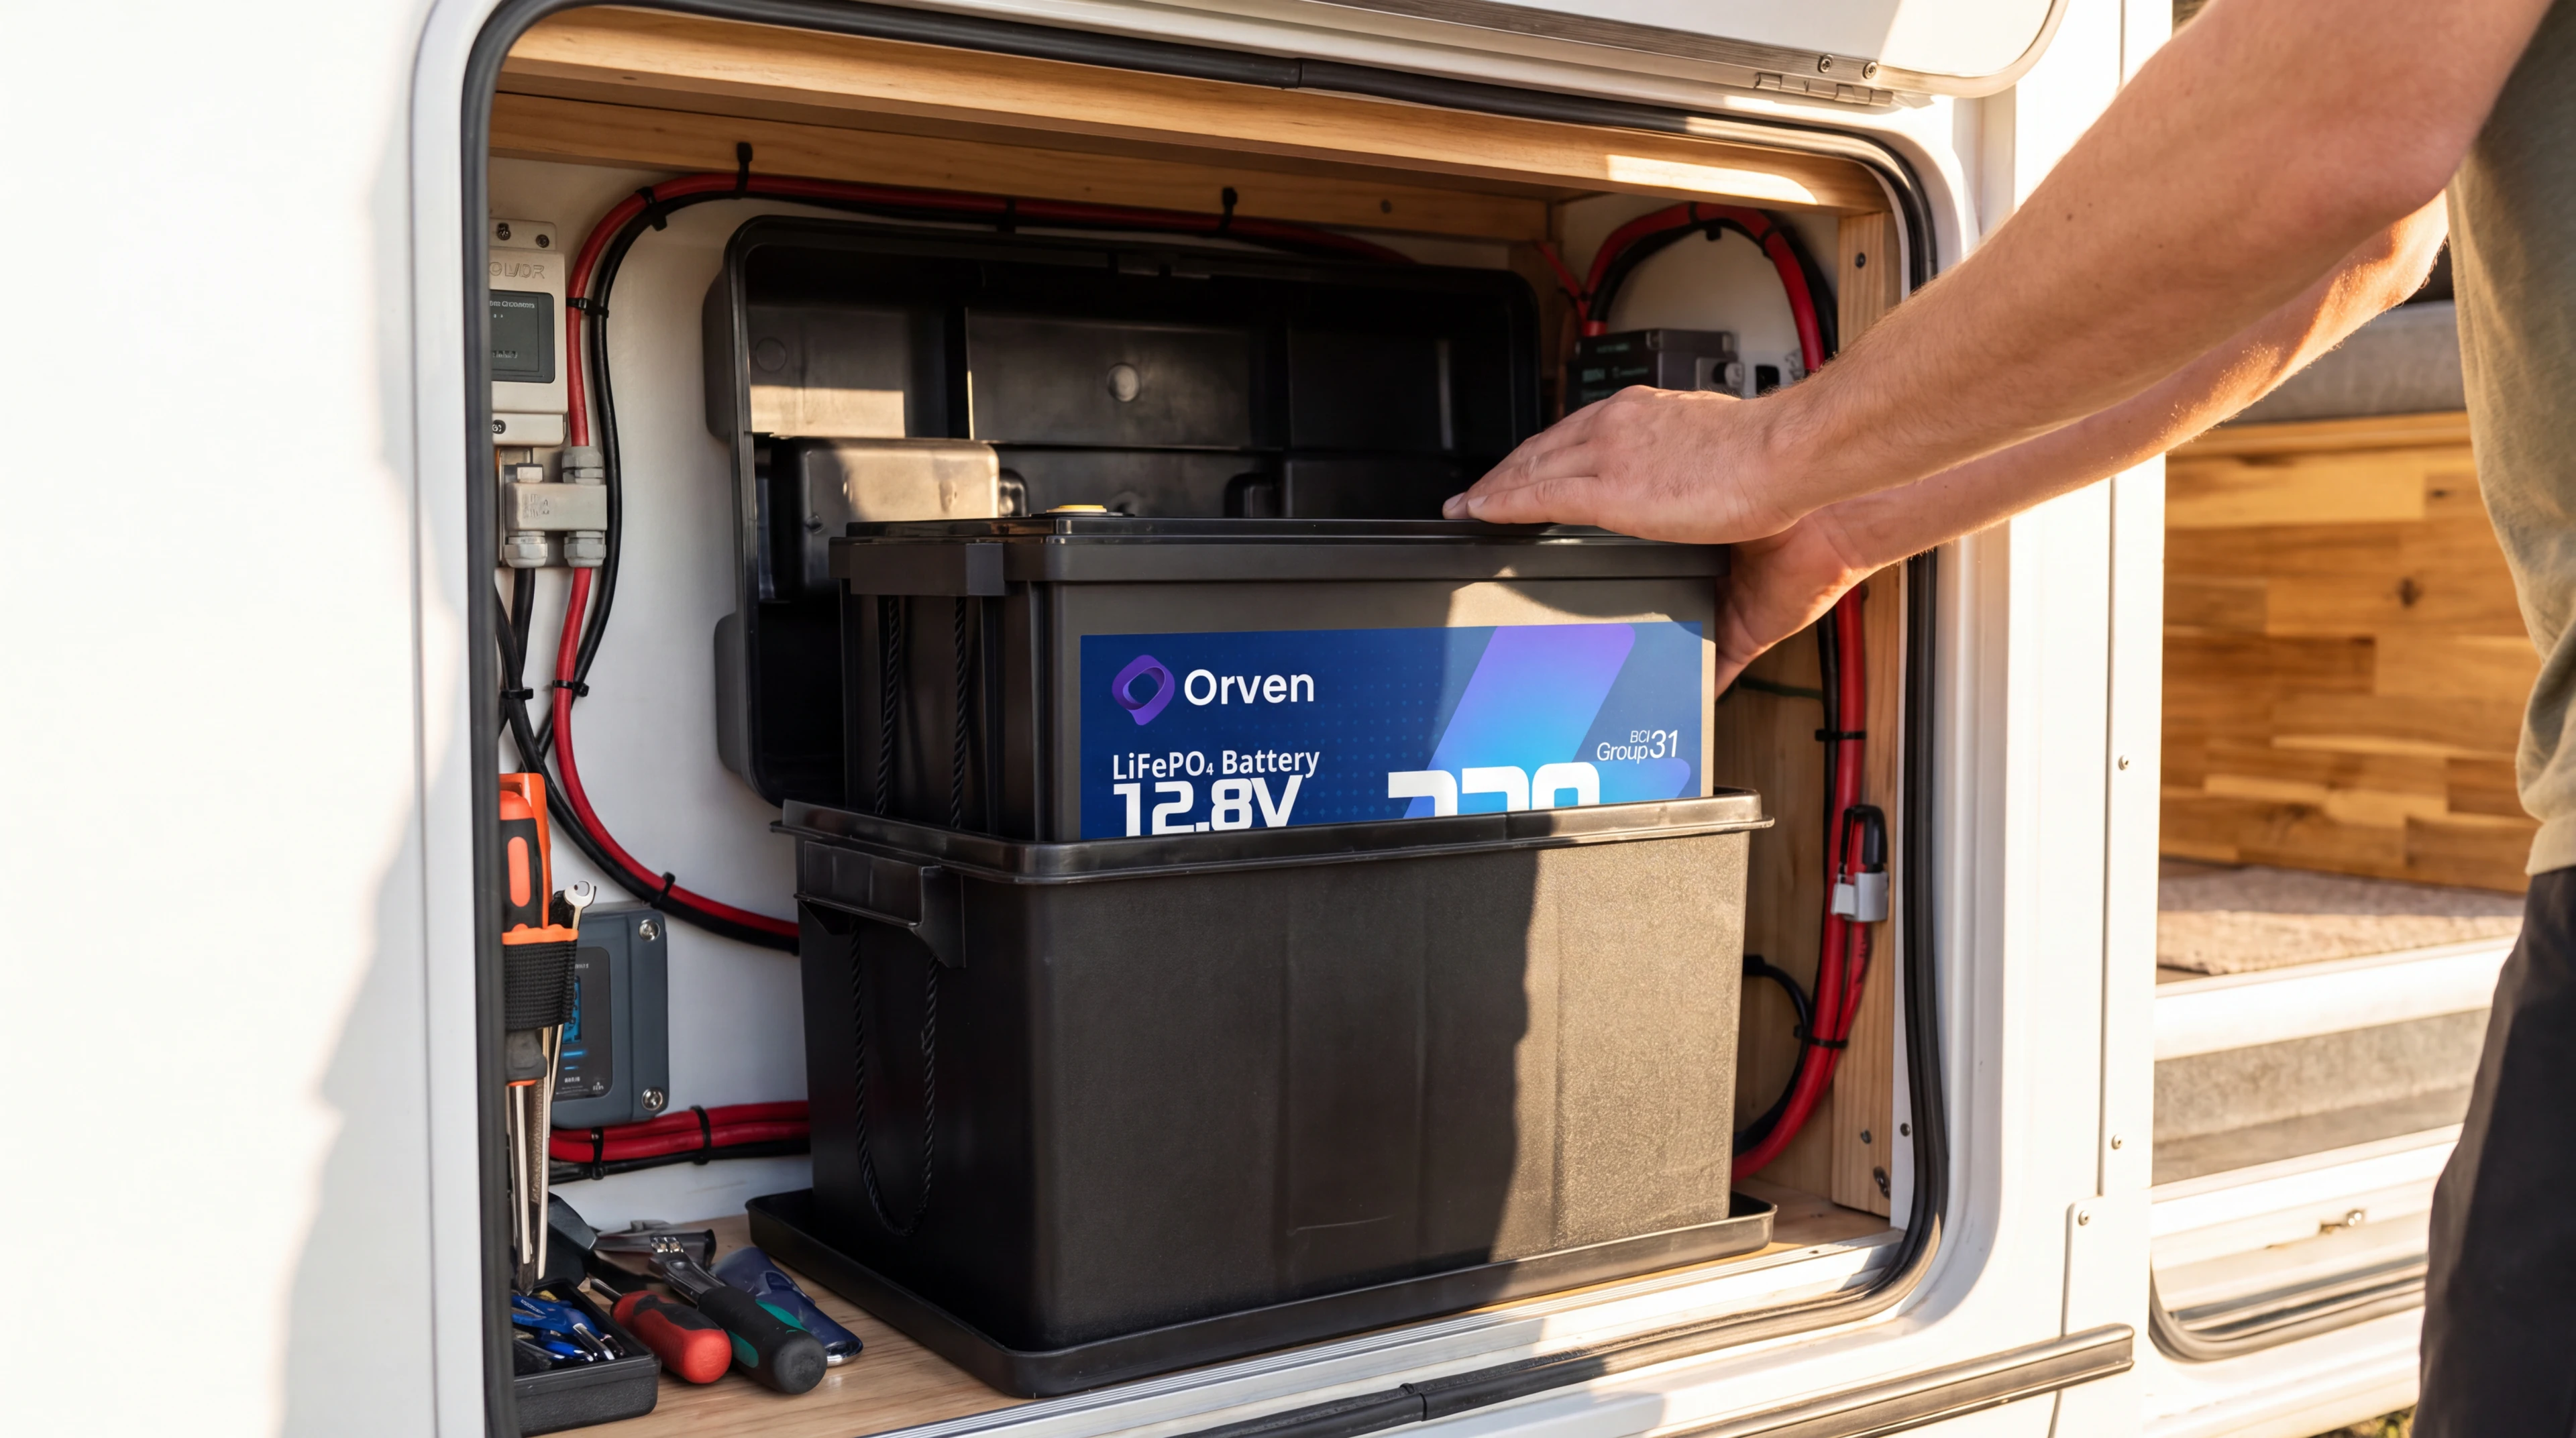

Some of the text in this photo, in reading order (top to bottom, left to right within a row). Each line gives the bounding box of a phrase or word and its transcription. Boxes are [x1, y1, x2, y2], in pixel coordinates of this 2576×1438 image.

[1184, 669, 1314, 706] Orven
[1629, 730, 1651, 744] BCI
[1222, 749, 1320, 779] Battery
[1114, 775, 1303, 837] 12.8V
